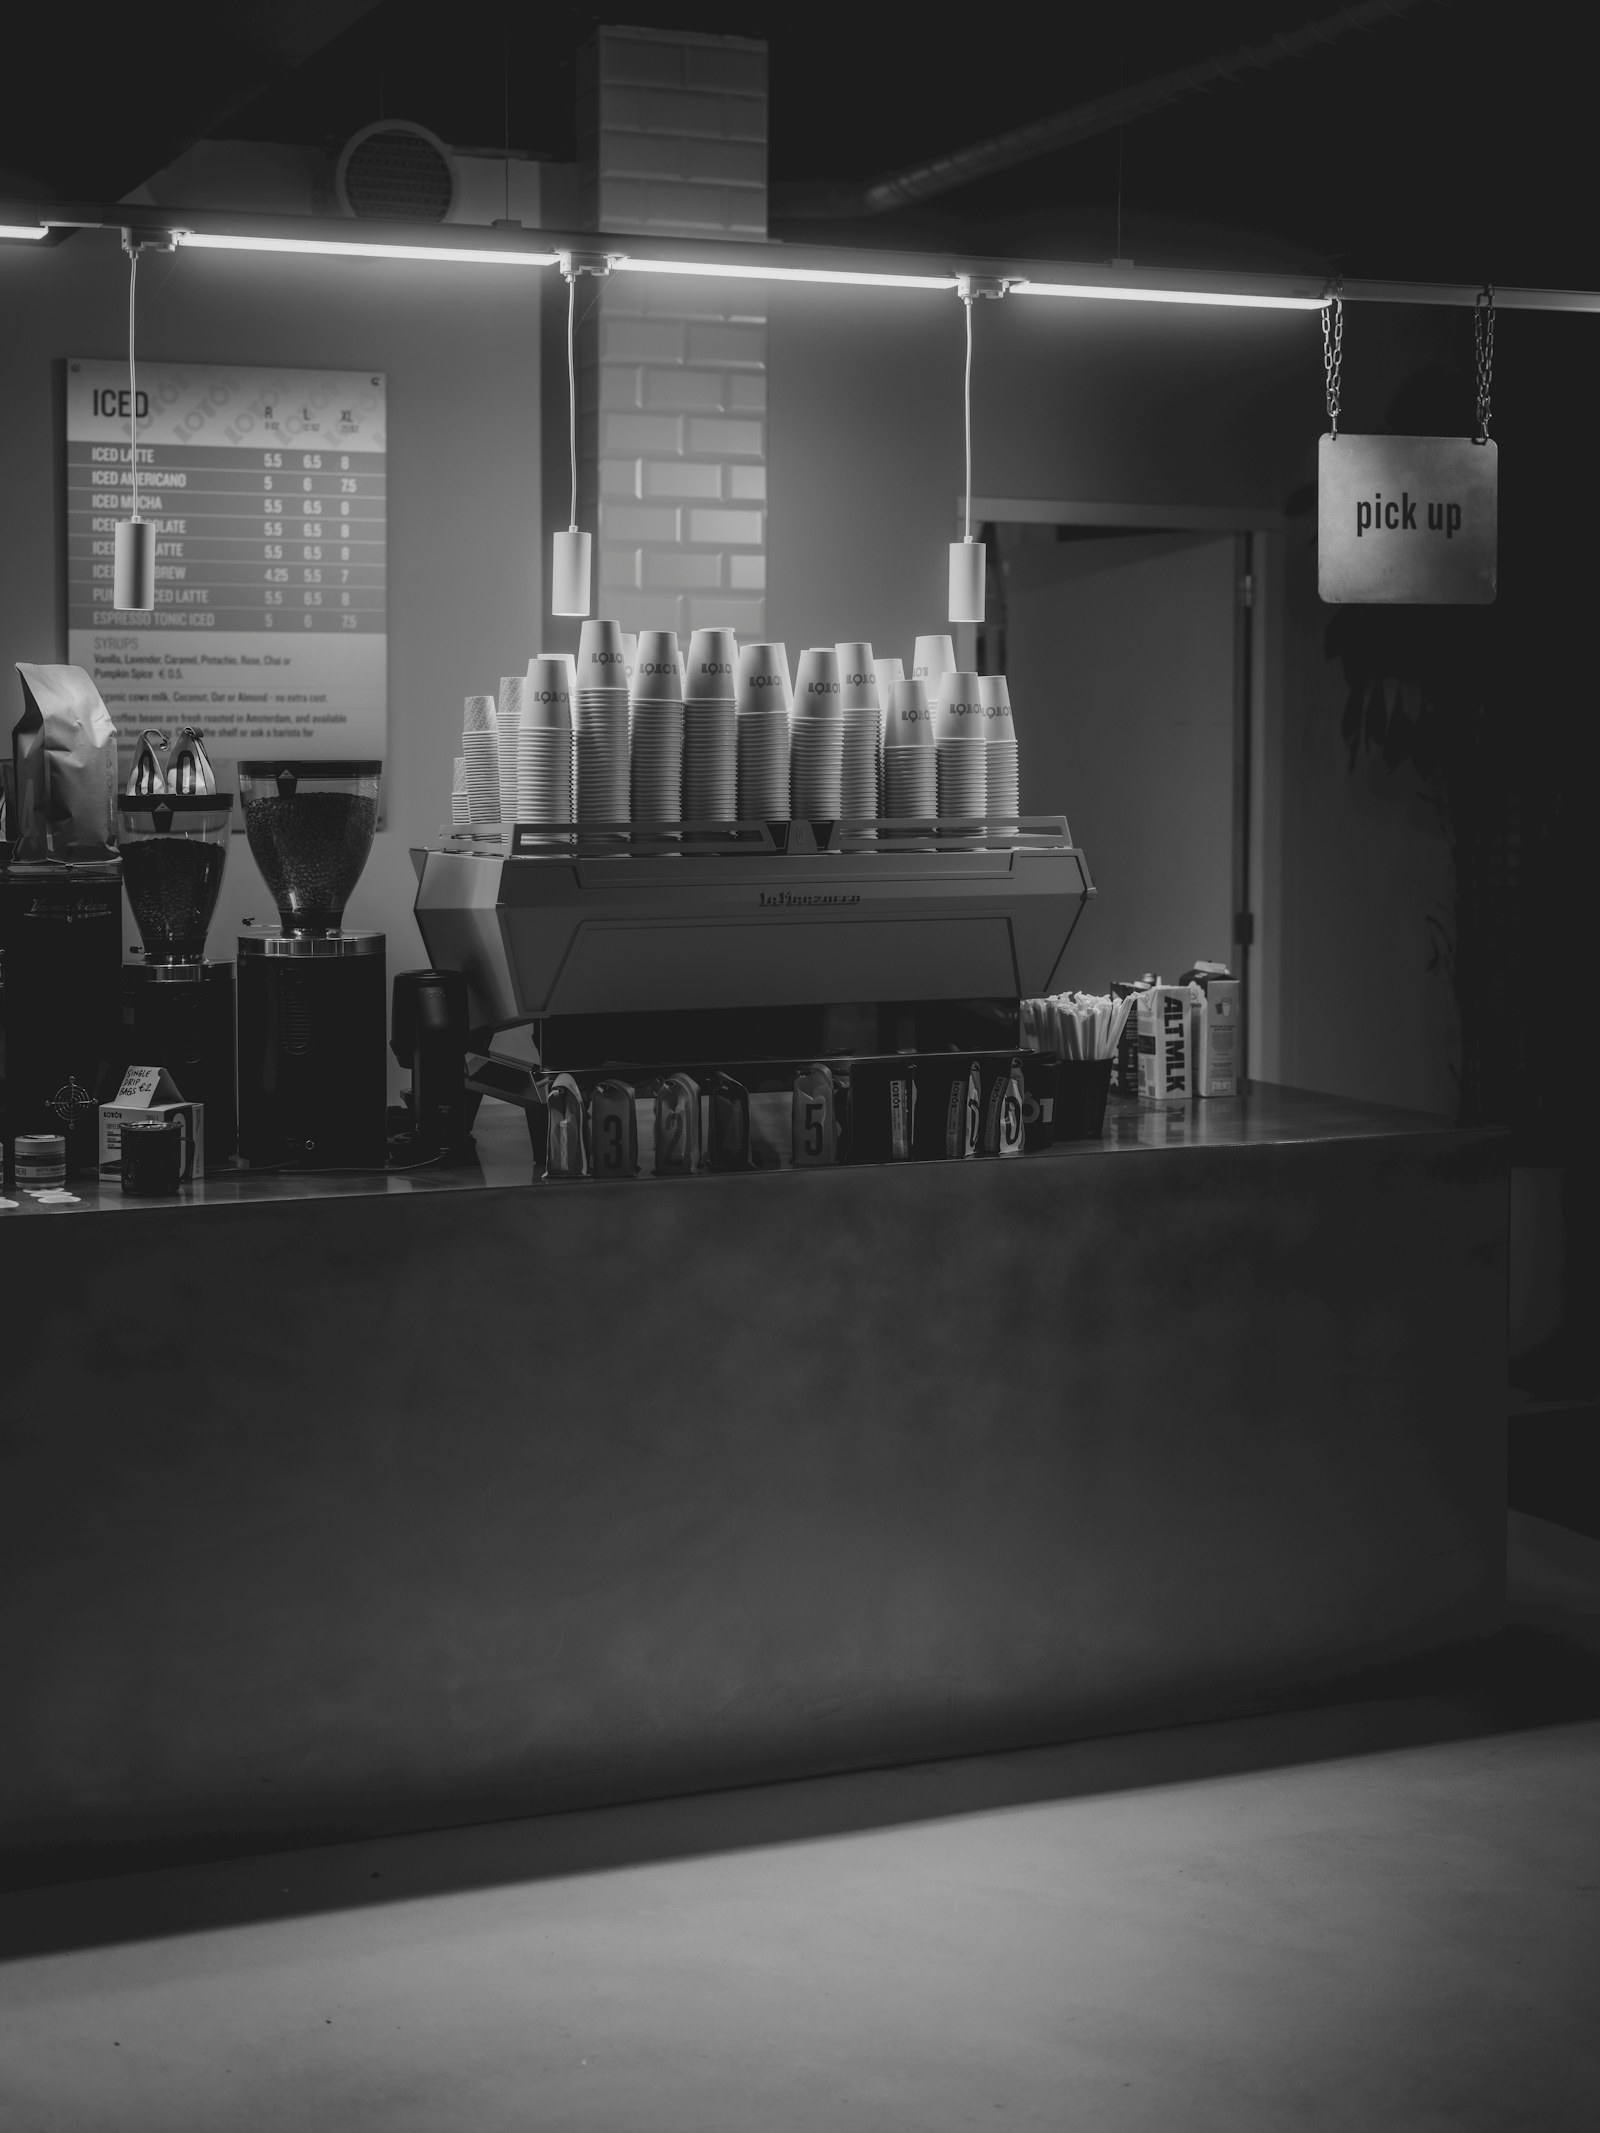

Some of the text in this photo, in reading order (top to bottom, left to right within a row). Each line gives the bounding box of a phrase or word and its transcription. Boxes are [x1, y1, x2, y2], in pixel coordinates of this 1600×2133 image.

[93, 389, 149, 418] ICED
[265, 406, 273, 419] R
[92, 447, 118, 462] ICED
[120, 448, 154, 463] LATTE
[263, 453, 282, 468] 5.5
[303, 454, 322, 469] 6.5
[92, 471, 357, 493] ICED AMERICANO 5 6 7.5
[92, 494, 118, 508] ICED
[120, 495, 162, 510] MOCHA
[263, 499, 282, 514] 5.5
[303, 500, 322, 515] 6.5
[1357, 492, 1462, 539] pick up
[263, 522, 282, 536] 5.5
[303, 523, 322, 537] 6.5
[263, 545, 282, 559] 5.5
[154, 566, 186, 580] BREW
[263, 568, 289, 582] 4.25
[303, 569, 322, 583] 5.5
[341, 569, 350, 583] 7
[153, 589, 173, 603] CED
[175, 589, 210, 603] LATTE
[264, 591, 282, 605] 5.5
[93, 611, 151, 626] ESPRESSO
[153, 612, 187, 627] TONIC
[188, 613, 215, 627] ICED
[264, 613, 272, 628] 5
[304, 614, 312, 628] 6
[93, 636, 139, 650] SYRUPS
[94, 654, 122, 665] Vanilla,
[124, 654, 163, 665] Lavender,
[94, 668, 130, 680] Pumpkin
[131, 669, 153, 680] Spice
[238, 692, 268, 702] Almond
[138, 713, 163, 723] beans
[181, 713, 200, 723] fresh
[203, 714, 234, 724] roasted
[237, 714, 244, 724] in
[295, 714, 311, 724] and
[1164, 996, 1186, 1092] ALT MLK
[127, 1069, 153, 1078] SINGLE
[119, 1082, 152, 1096] BAGS €2
[122, 1078, 141, 1087] DRIP
[804, 1103, 823, 1157] 5
[603, 1114, 623, 1170] 3
[664, 1111, 684, 1166] 2
